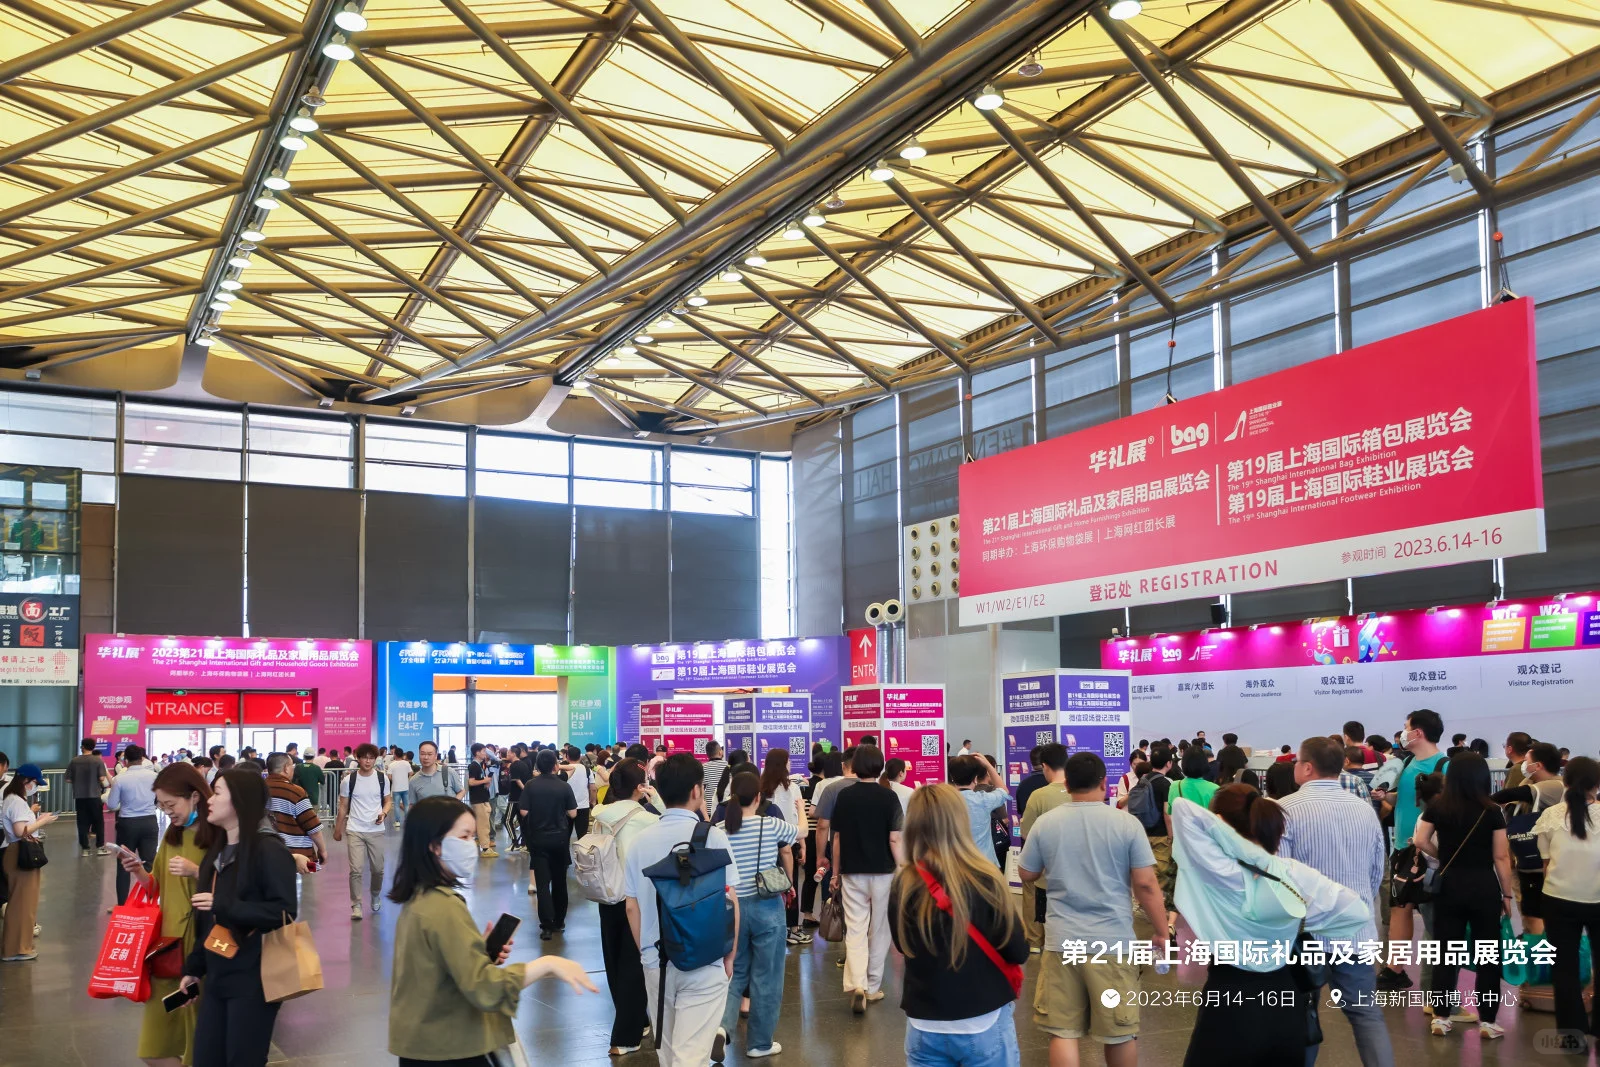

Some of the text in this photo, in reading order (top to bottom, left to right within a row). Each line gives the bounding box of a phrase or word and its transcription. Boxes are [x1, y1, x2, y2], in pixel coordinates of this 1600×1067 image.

[1171, 422, 1209, 449] bag
[1227, 406, 1472, 483] 第19届上海国际箱包展览会
[1255, 473, 1287, 486] Shanghai
[1290, 463, 1337, 478] International
[1339, 459, 1353, 469] Bag
[1356, 450, 1397, 465] Exhibition
[1228, 444, 1474, 515] 第19届上海国际鞋业展览会
[982, 469, 1210, 536] 第21届上海国际礼品及家居用品展览会
[1228, 517, 1240, 525] The
[1257, 508, 1288, 520] Shanghai
[1290, 498, 1338, 513] International
[1341, 490, 1376, 504] Footwear
[1379, 482, 1421, 497] Exhibition
[1104, 515, 1176, 540] 上海网红团长展
[1341, 527, 1503, 564] 参观时间 2023.6.14-16
[1089, 560, 1278, 602] 登记处 REGISTRATION
[976, 594, 1045, 614] W1/W2/E1/E2
[1162, 646, 1182, 661] bag
[178, 659, 207, 667] Shanghai
[677, 662, 797, 677] 第19届上海国际鞋业展览会
[1517, 663, 1562, 675] 观众登记
[1320, 675, 1354, 685] 观众登记
[1408, 670, 1447, 681] 观众登记
[1245, 679, 1275, 688] 海外观众
[1421, 684, 1457, 692] Registration
[1531, 678, 1574, 687] Registration
[1331, 688, 1363, 696] Registration
[398, 712, 418, 721] Hall
[571, 711, 592, 721] Hall
[398, 722, 424, 730] E4-E7
[571, 721, 584, 729] E3
